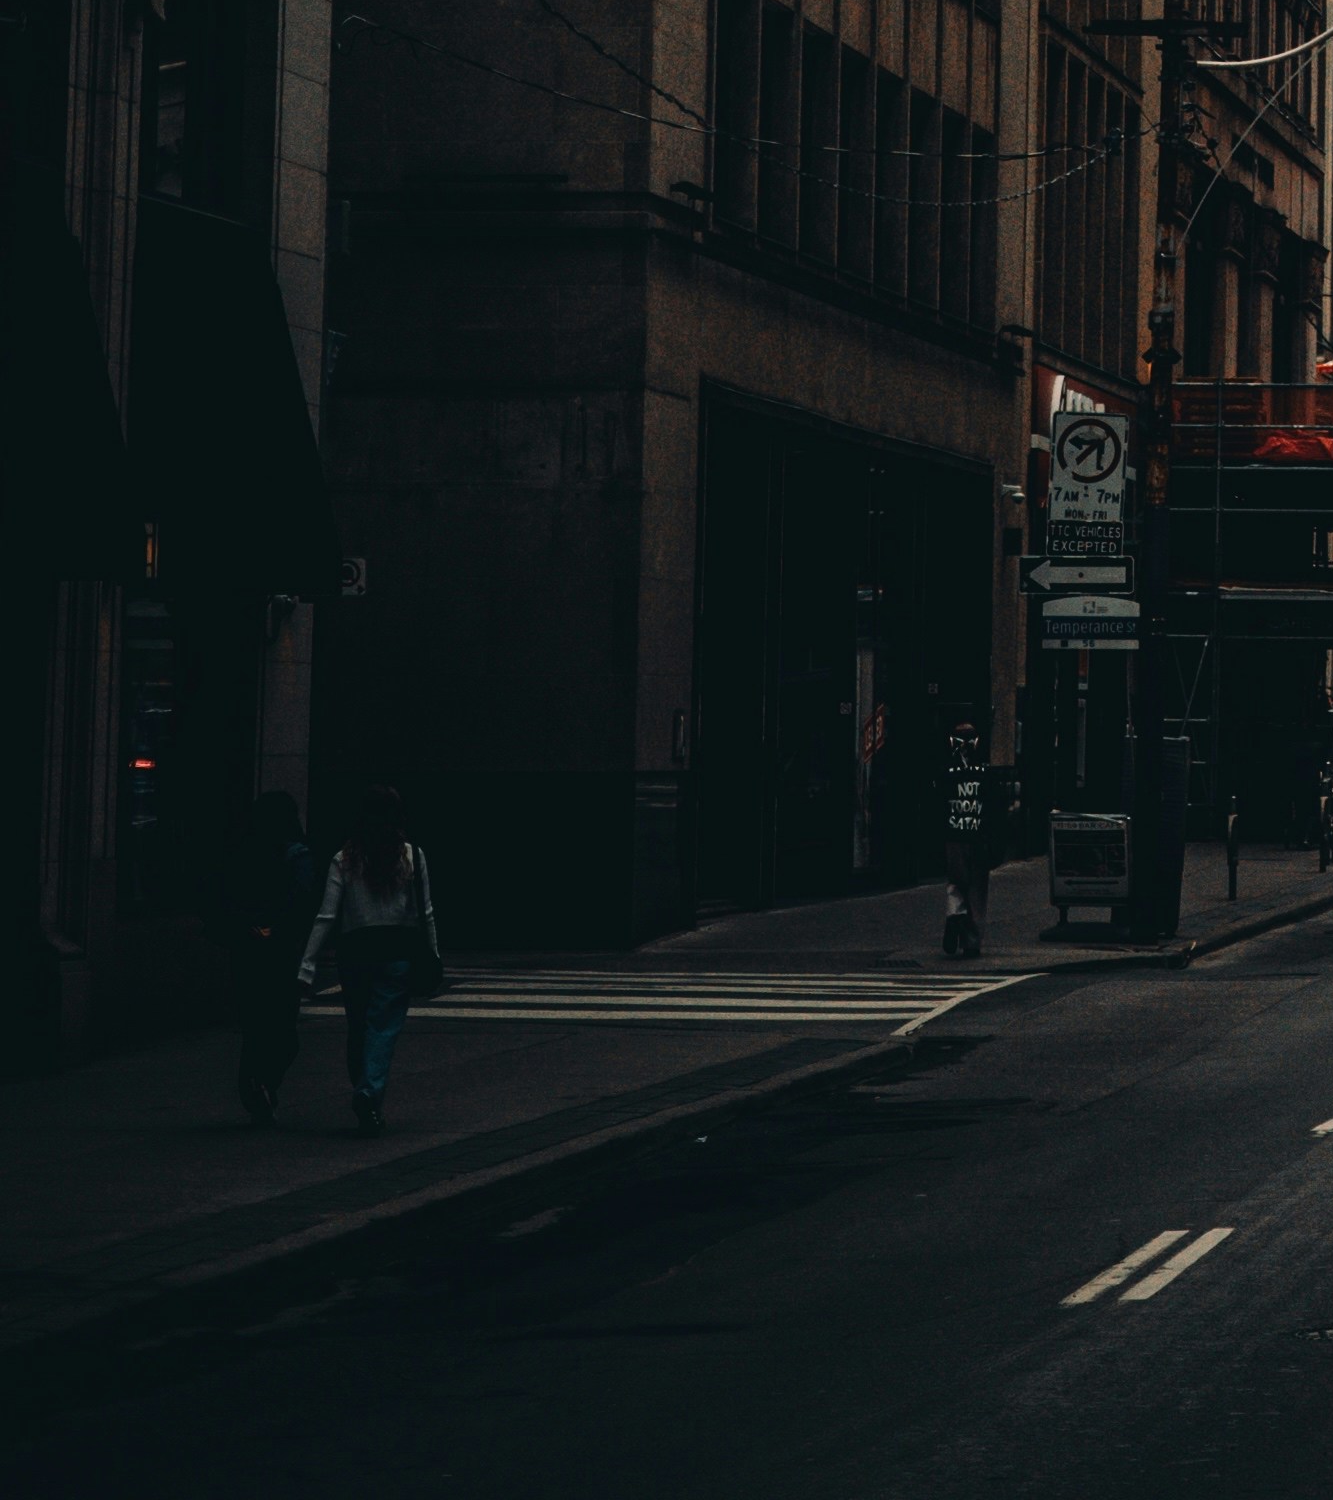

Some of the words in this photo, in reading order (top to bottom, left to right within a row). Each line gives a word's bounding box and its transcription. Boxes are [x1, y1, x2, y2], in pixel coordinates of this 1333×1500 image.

[1050, 524, 1071, 537] TTC
[1075, 525, 1121, 539] VEHICLES
[1052, 540, 1117, 553] EXCEPTED
[1046, 619, 1124, 637] Temperance
[1126, 620, 1136, 633] St
[957, 781, 981, 797] NOT
